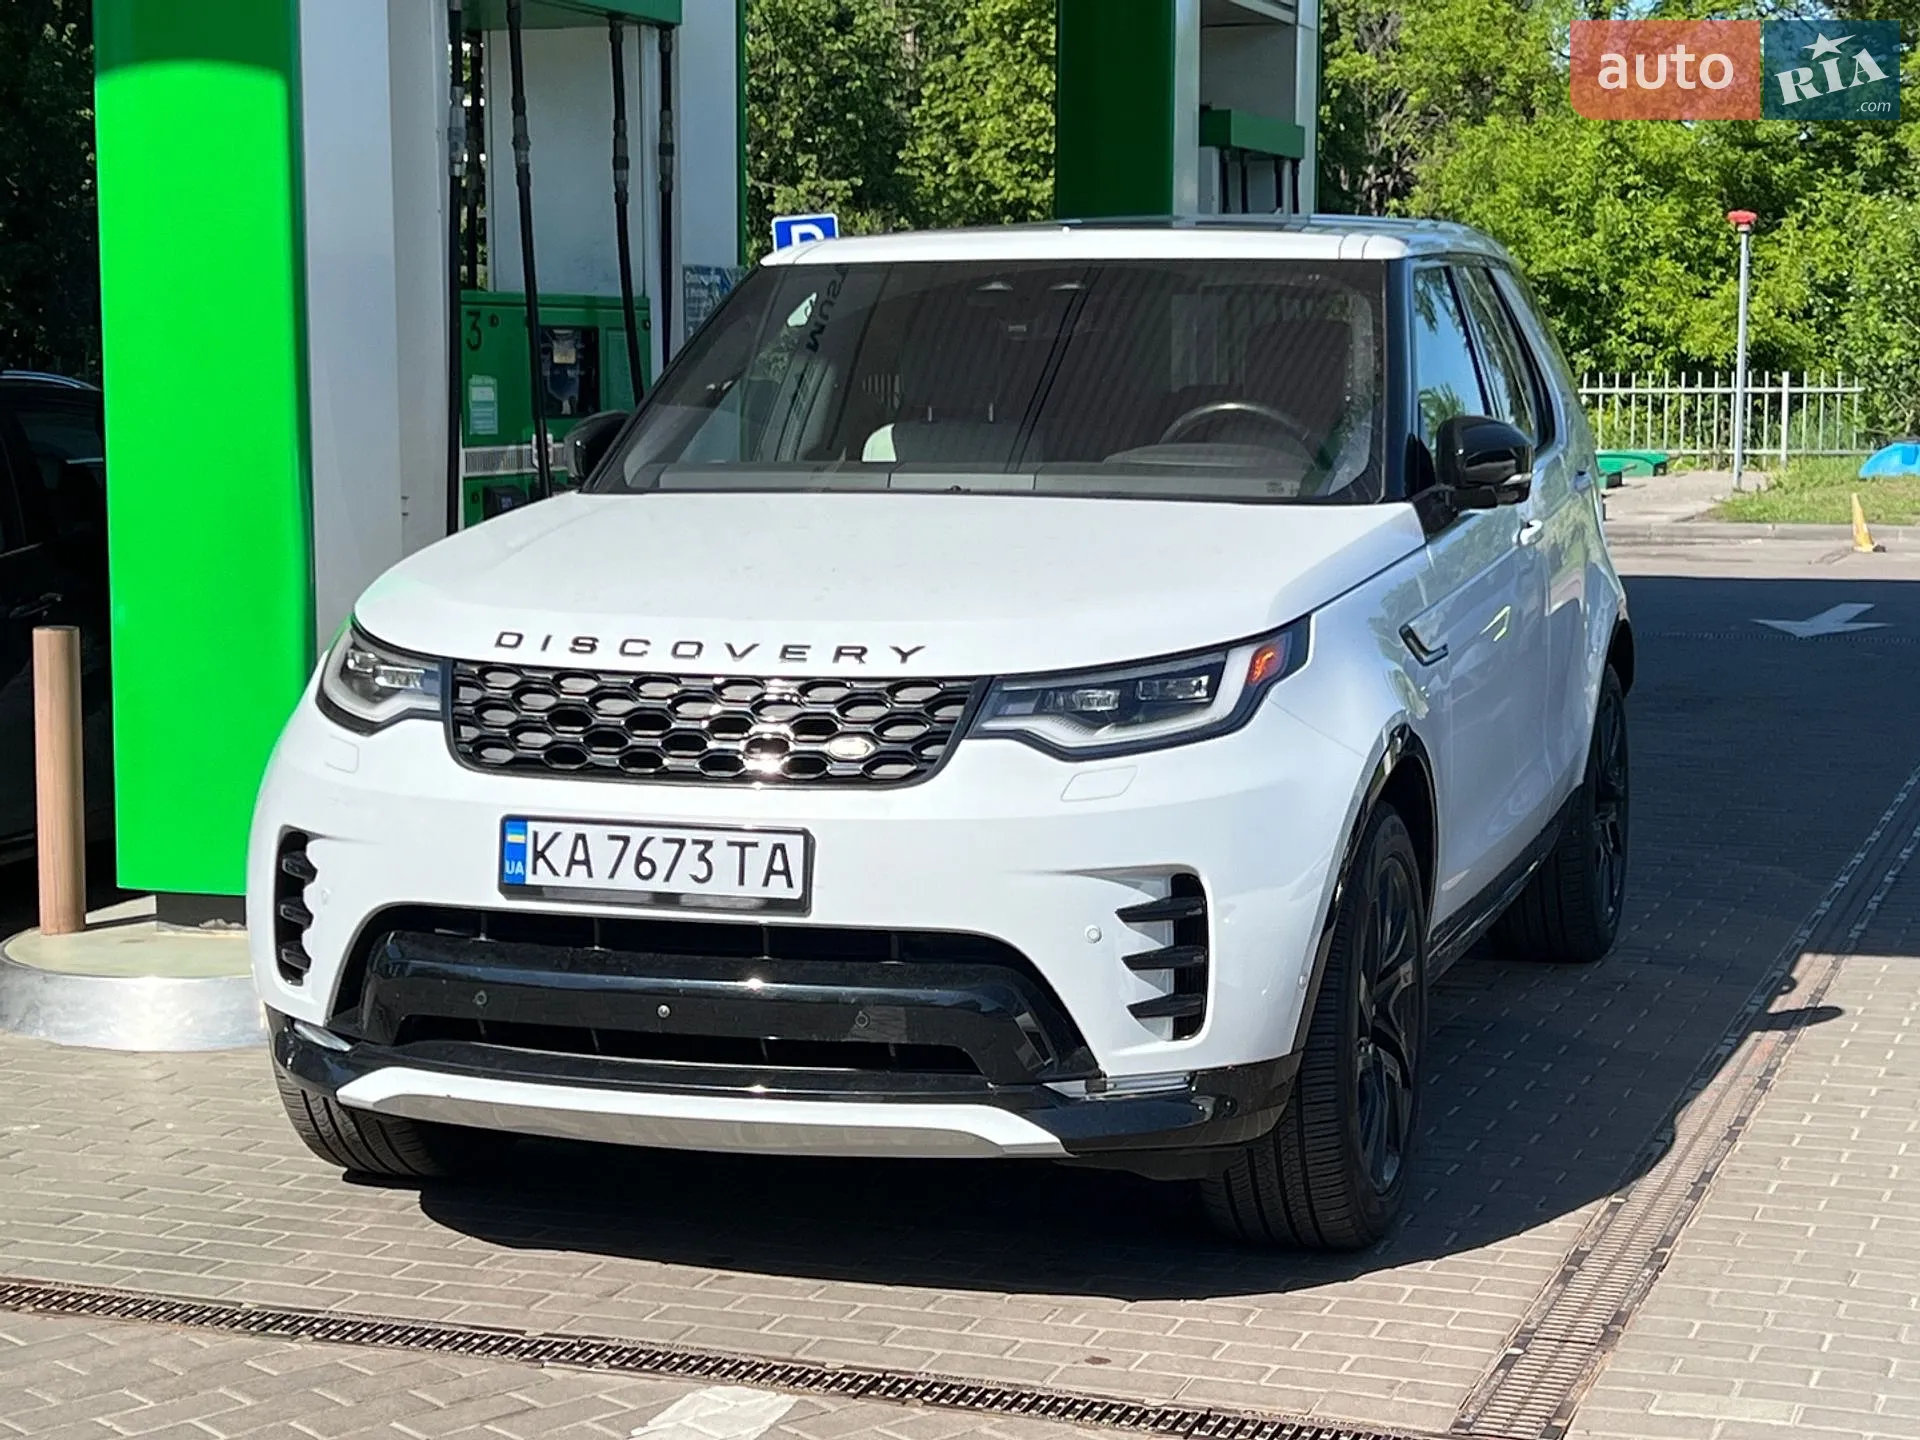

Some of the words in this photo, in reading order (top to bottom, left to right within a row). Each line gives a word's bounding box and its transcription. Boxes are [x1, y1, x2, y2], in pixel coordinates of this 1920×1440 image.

[466, 311, 483, 351] 3
[494, 630, 926, 664] DISCOVERY
[505, 860, 525, 875] UA
[531, 830, 594, 878] KA
[607, 834, 714, 884] 7673
[726, 840, 794, 888] TA
